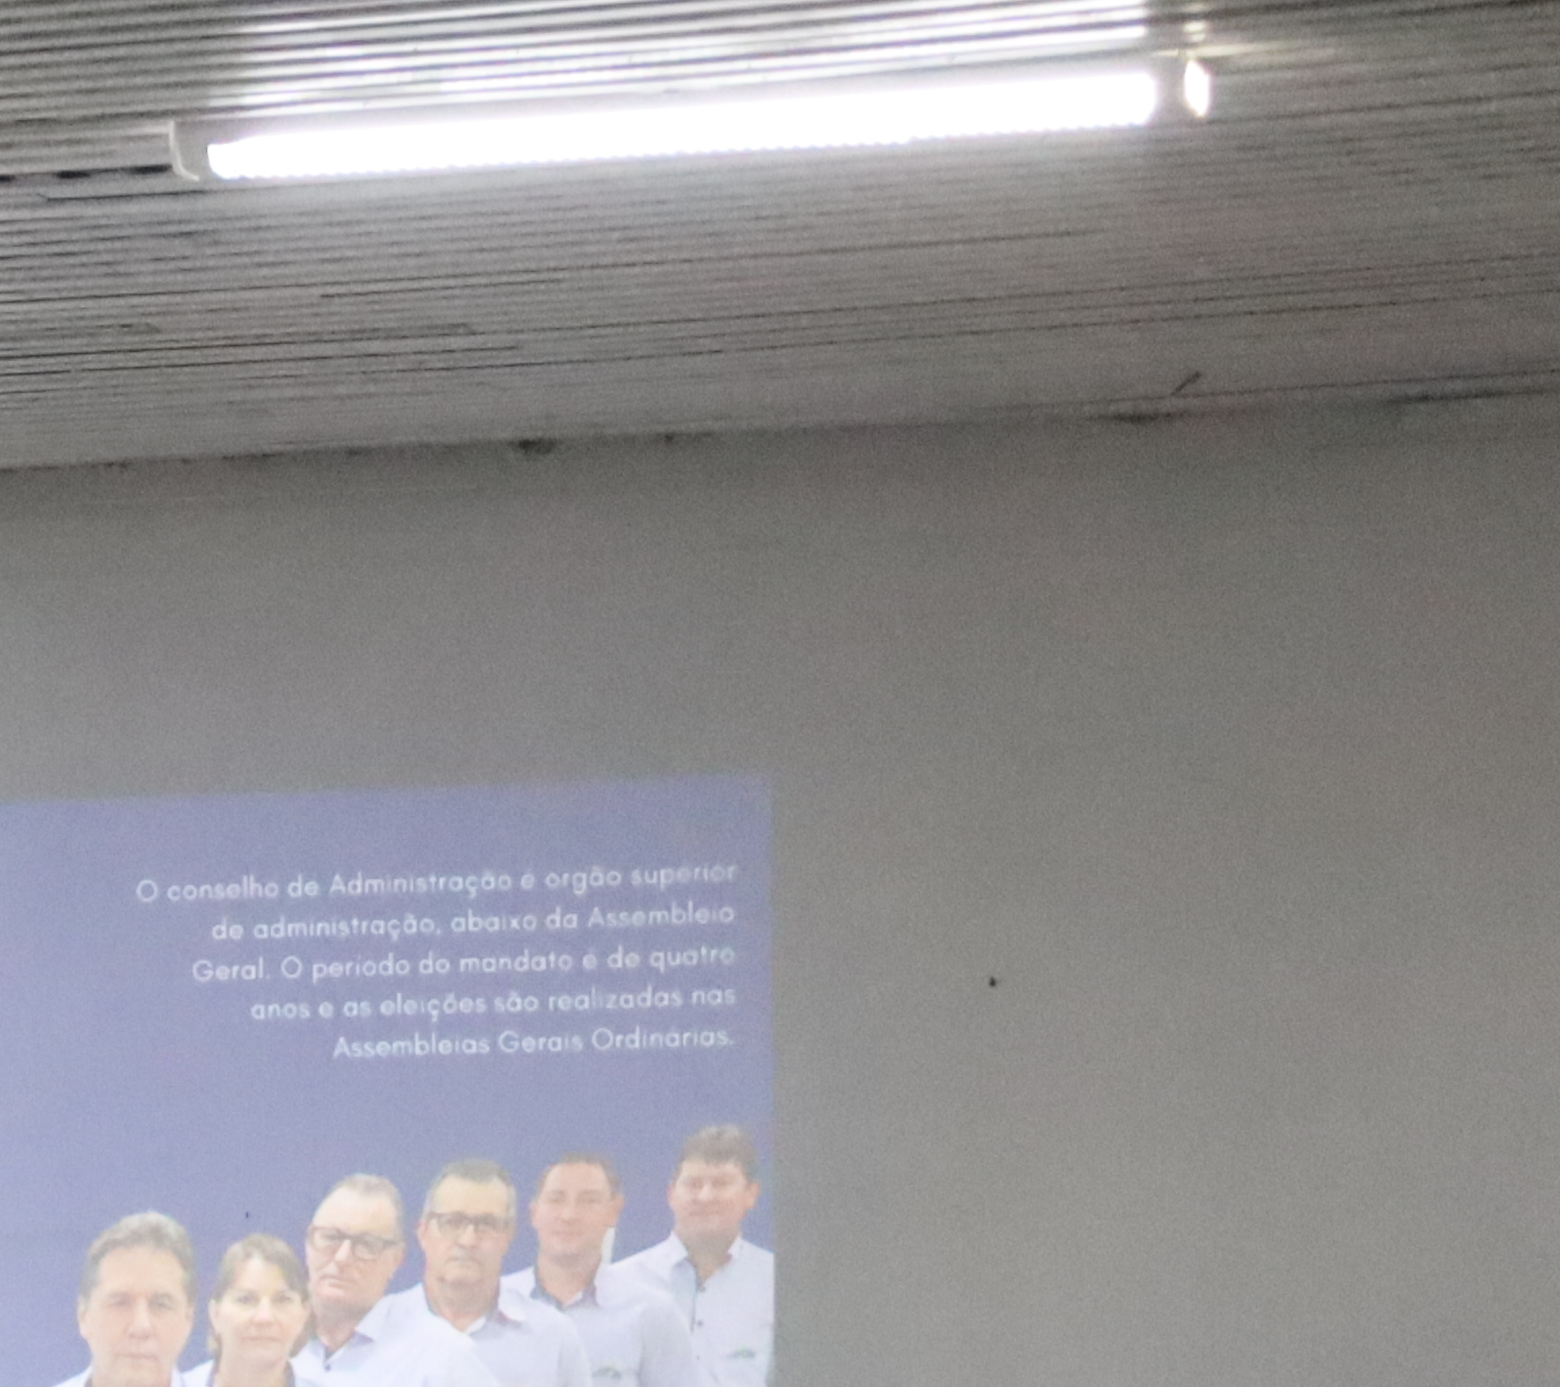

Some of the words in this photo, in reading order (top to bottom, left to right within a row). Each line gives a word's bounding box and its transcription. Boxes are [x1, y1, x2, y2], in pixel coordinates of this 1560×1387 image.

[136, 879, 159, 902] O
[167, 875, 280, 902] conselho
[287, 874, 320, 899] de
[329, 870, 513, 898] Administração
[631, 864, 738, 891] superior
[212, 916, 244, 940] de
[450, 908, 537, 933] abaixo
[545, 905, 579, 930] da
[280, 955, 304, 980] O
[419, 951, 451, 975] do
[459, 948, 573, 973] mandato
[606, 945, 640, 968] de
[649, 946, 736, 974] quatro
[250, 1001, 311, 1020] anos
[318, 1001, 334, 1019] e
[343, 1000, 371, 1018] as
[380, 992, 487, 1022] eleições
[494, 990, 539, 1013] são
[548, 984, 683, 1012] realizadas
[691, 987, 737, 1006] nas
[332, 1031, 490, 1059] Assembleias
[498, 1029, 584, 1053] Gerais
